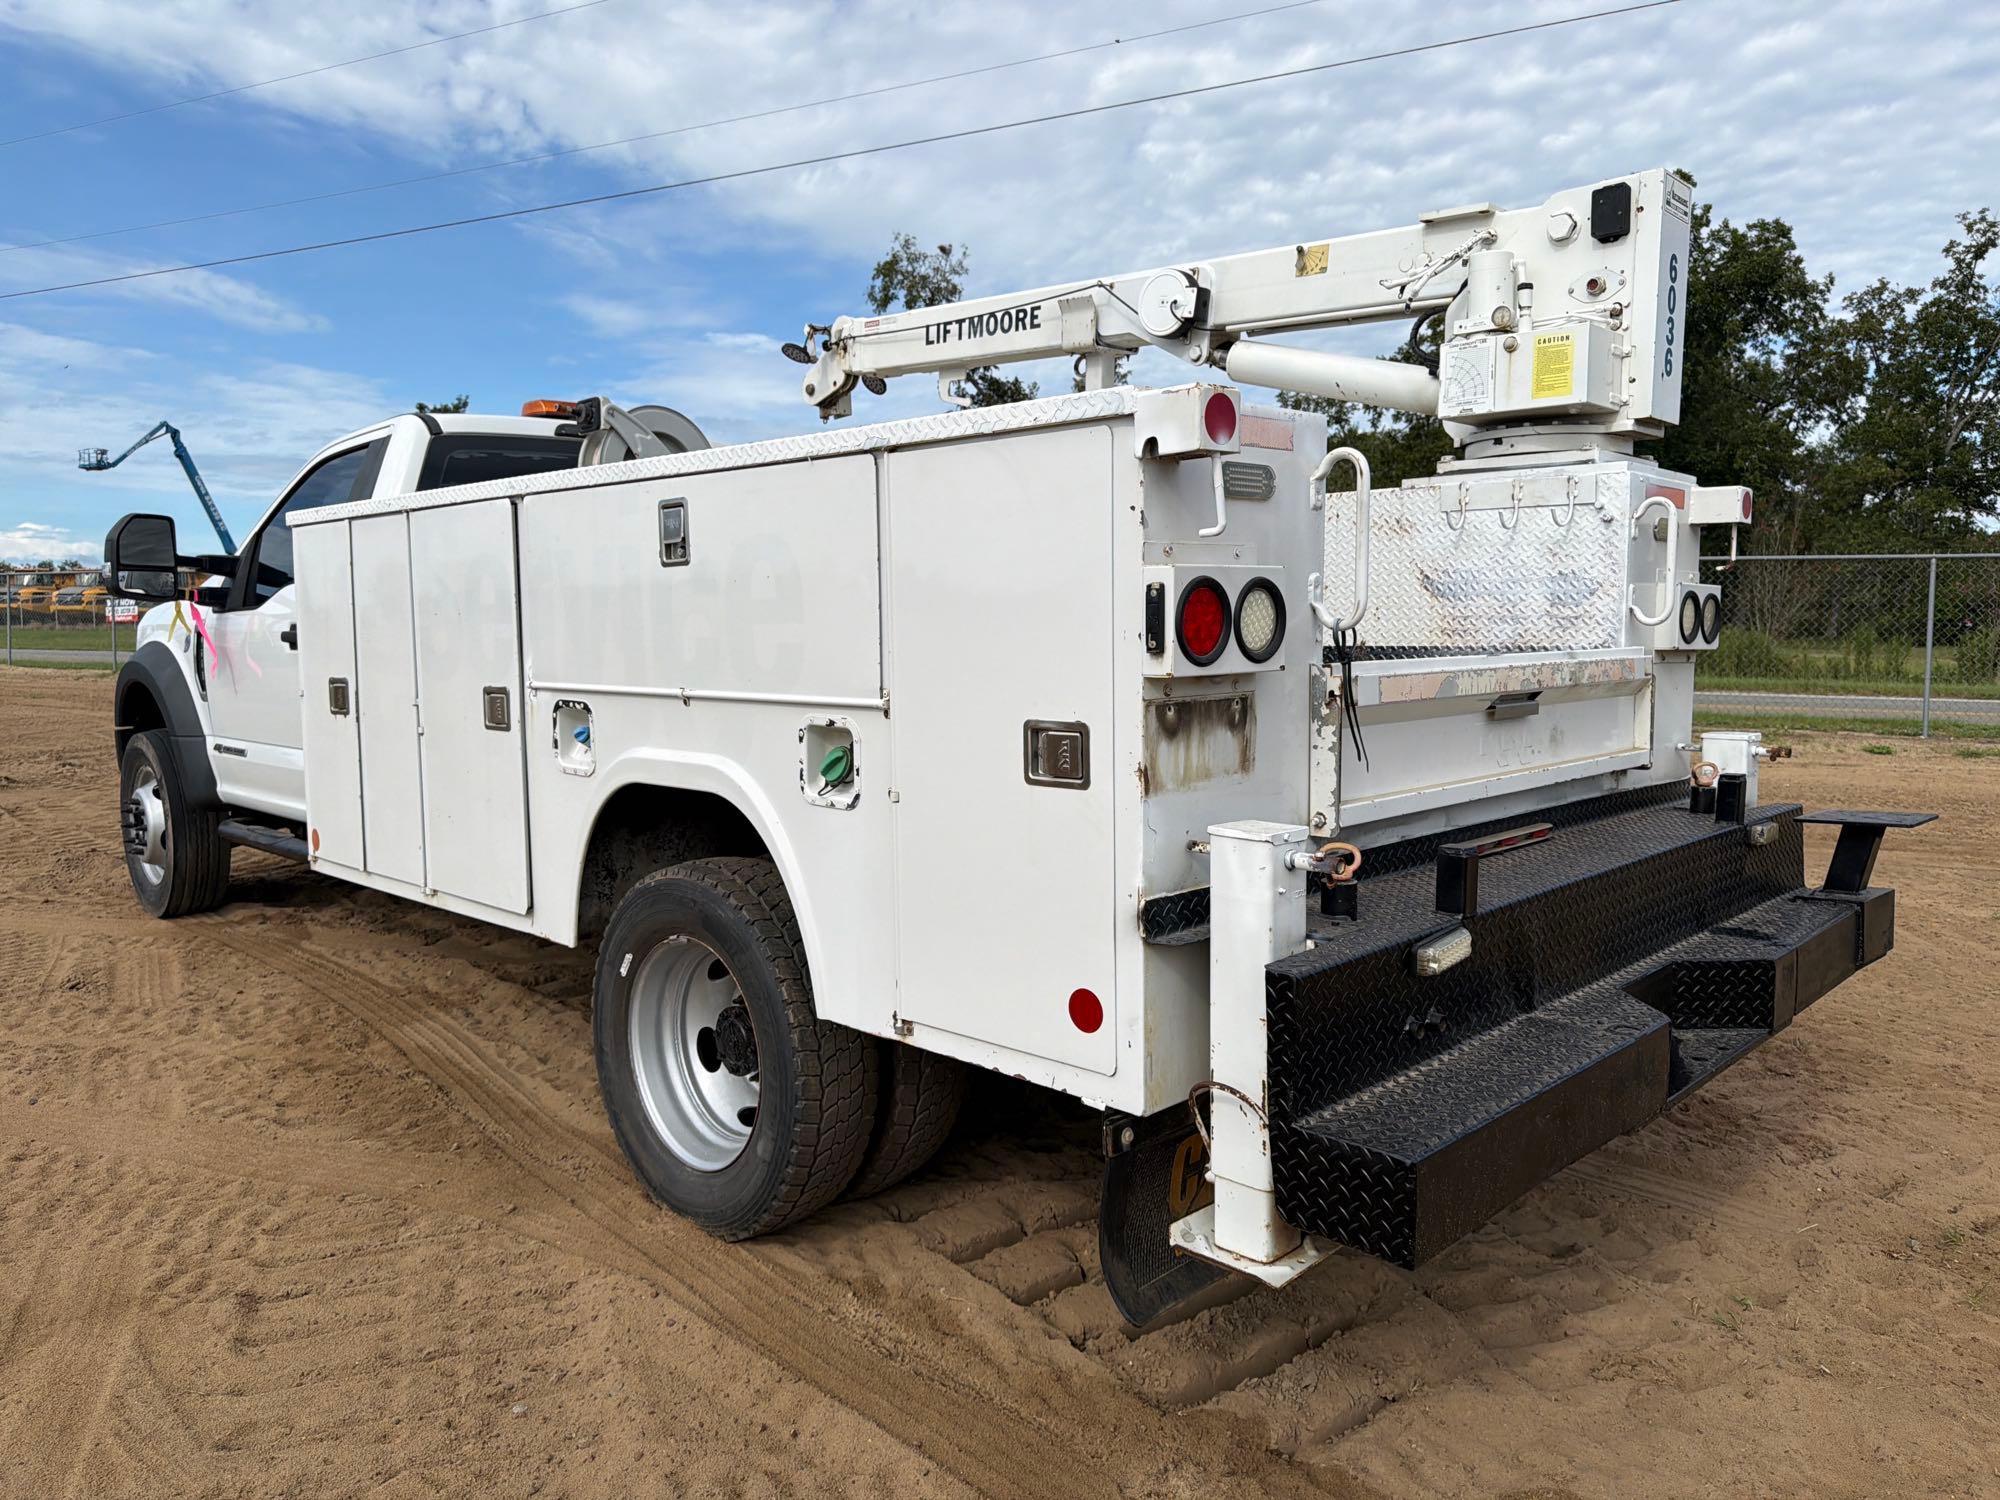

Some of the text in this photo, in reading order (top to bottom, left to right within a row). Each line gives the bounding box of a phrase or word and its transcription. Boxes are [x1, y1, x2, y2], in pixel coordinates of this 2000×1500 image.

[925, 305, 1041, 346] LIFTMOORE
[1664, 253, 1678, 377] 6036
[1537, 334, 1570, 345] CAUTION
